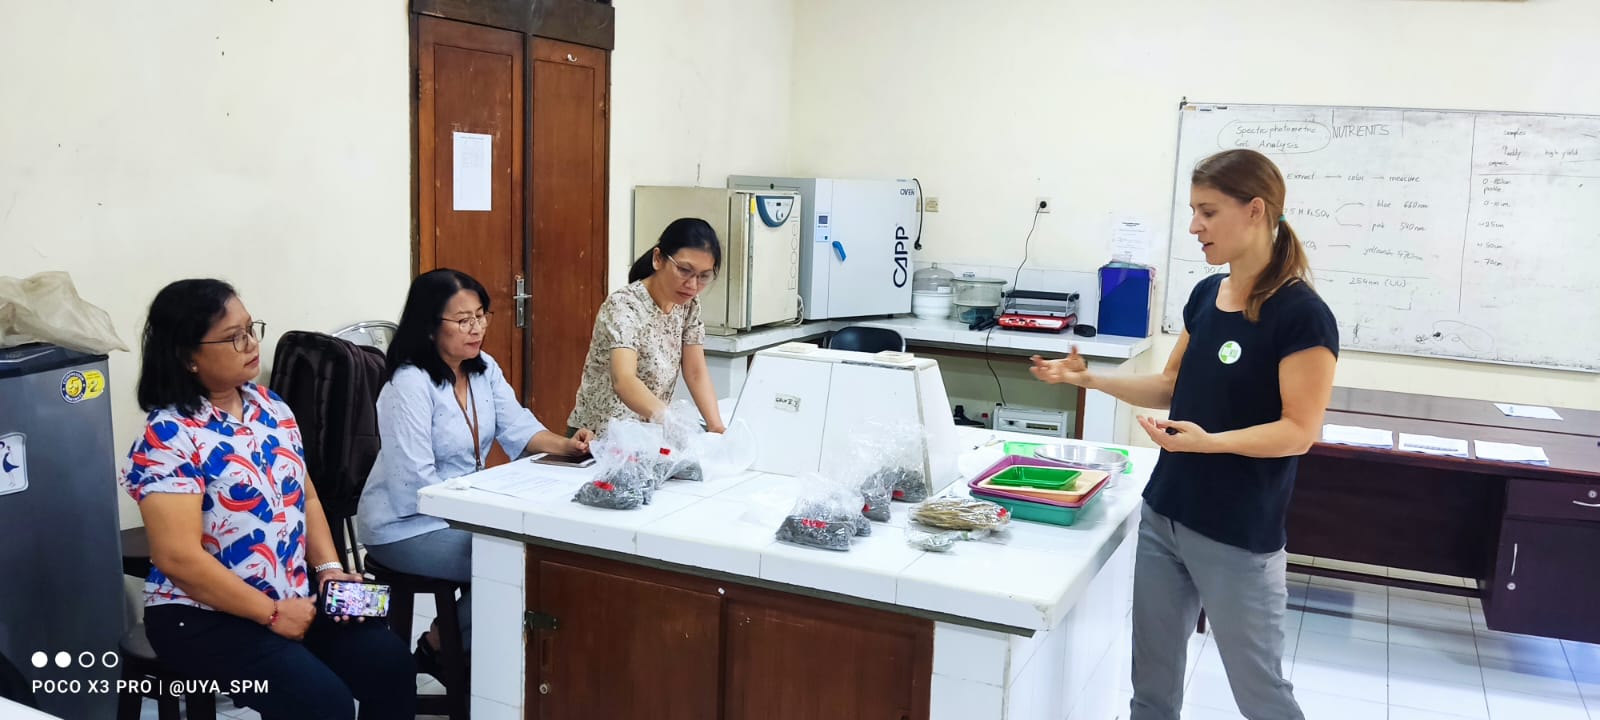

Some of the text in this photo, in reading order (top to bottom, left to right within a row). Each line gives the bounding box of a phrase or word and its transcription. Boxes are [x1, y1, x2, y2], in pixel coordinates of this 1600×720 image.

[1332, 124, 1390, 138] NUTRIENTS
[1258, 139, 1300, 152] Analysis
[892, 226, 910, 288] CAPP
